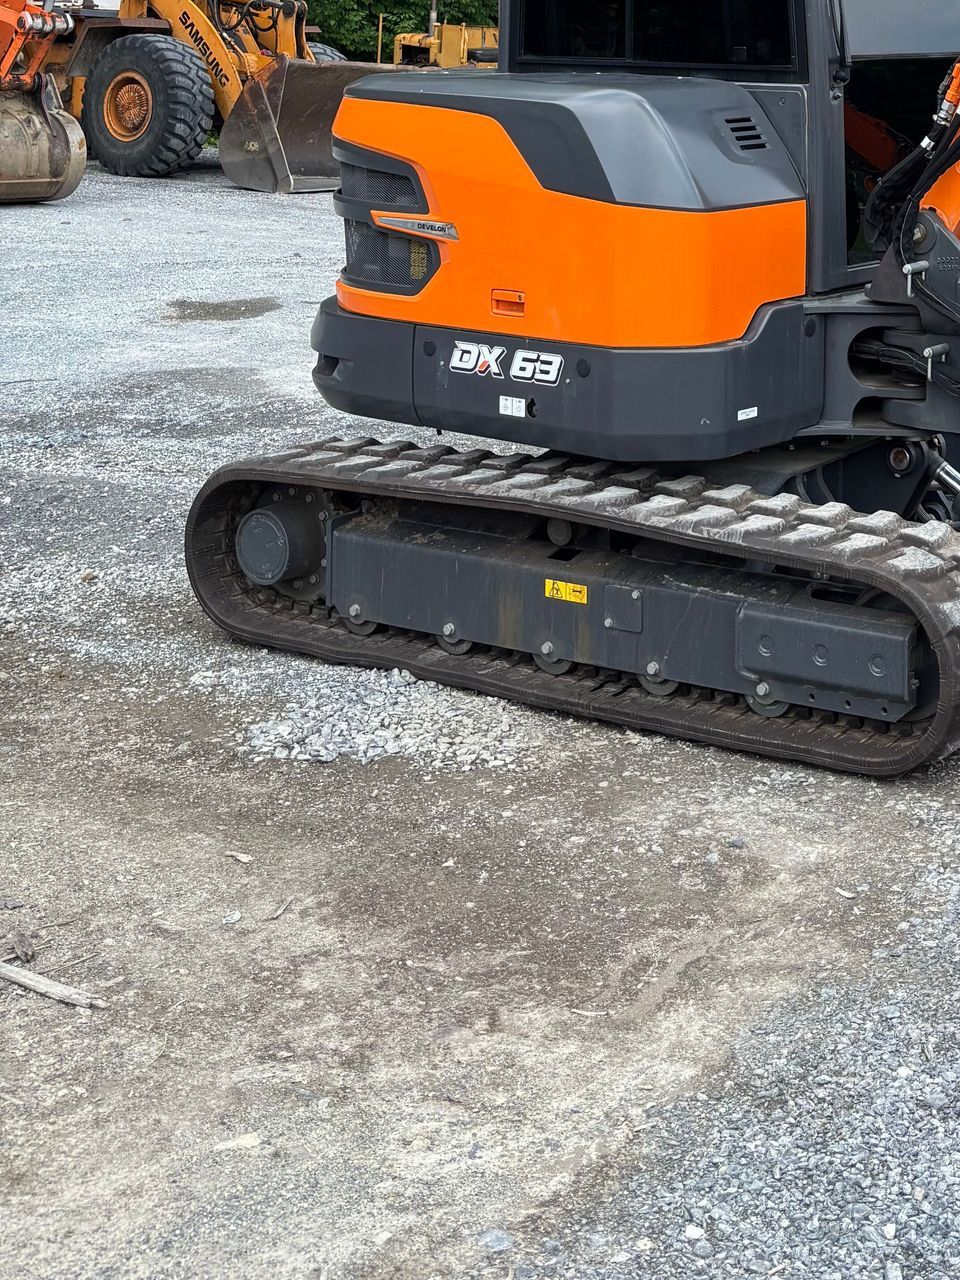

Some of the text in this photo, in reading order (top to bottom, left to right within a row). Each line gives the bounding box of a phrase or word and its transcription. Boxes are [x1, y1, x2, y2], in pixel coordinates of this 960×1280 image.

[178, 10, 231, 89] SAMSUNG
[417, 222, 447, 233] DEVELON
[449, 340, 564, 387] DX 63
